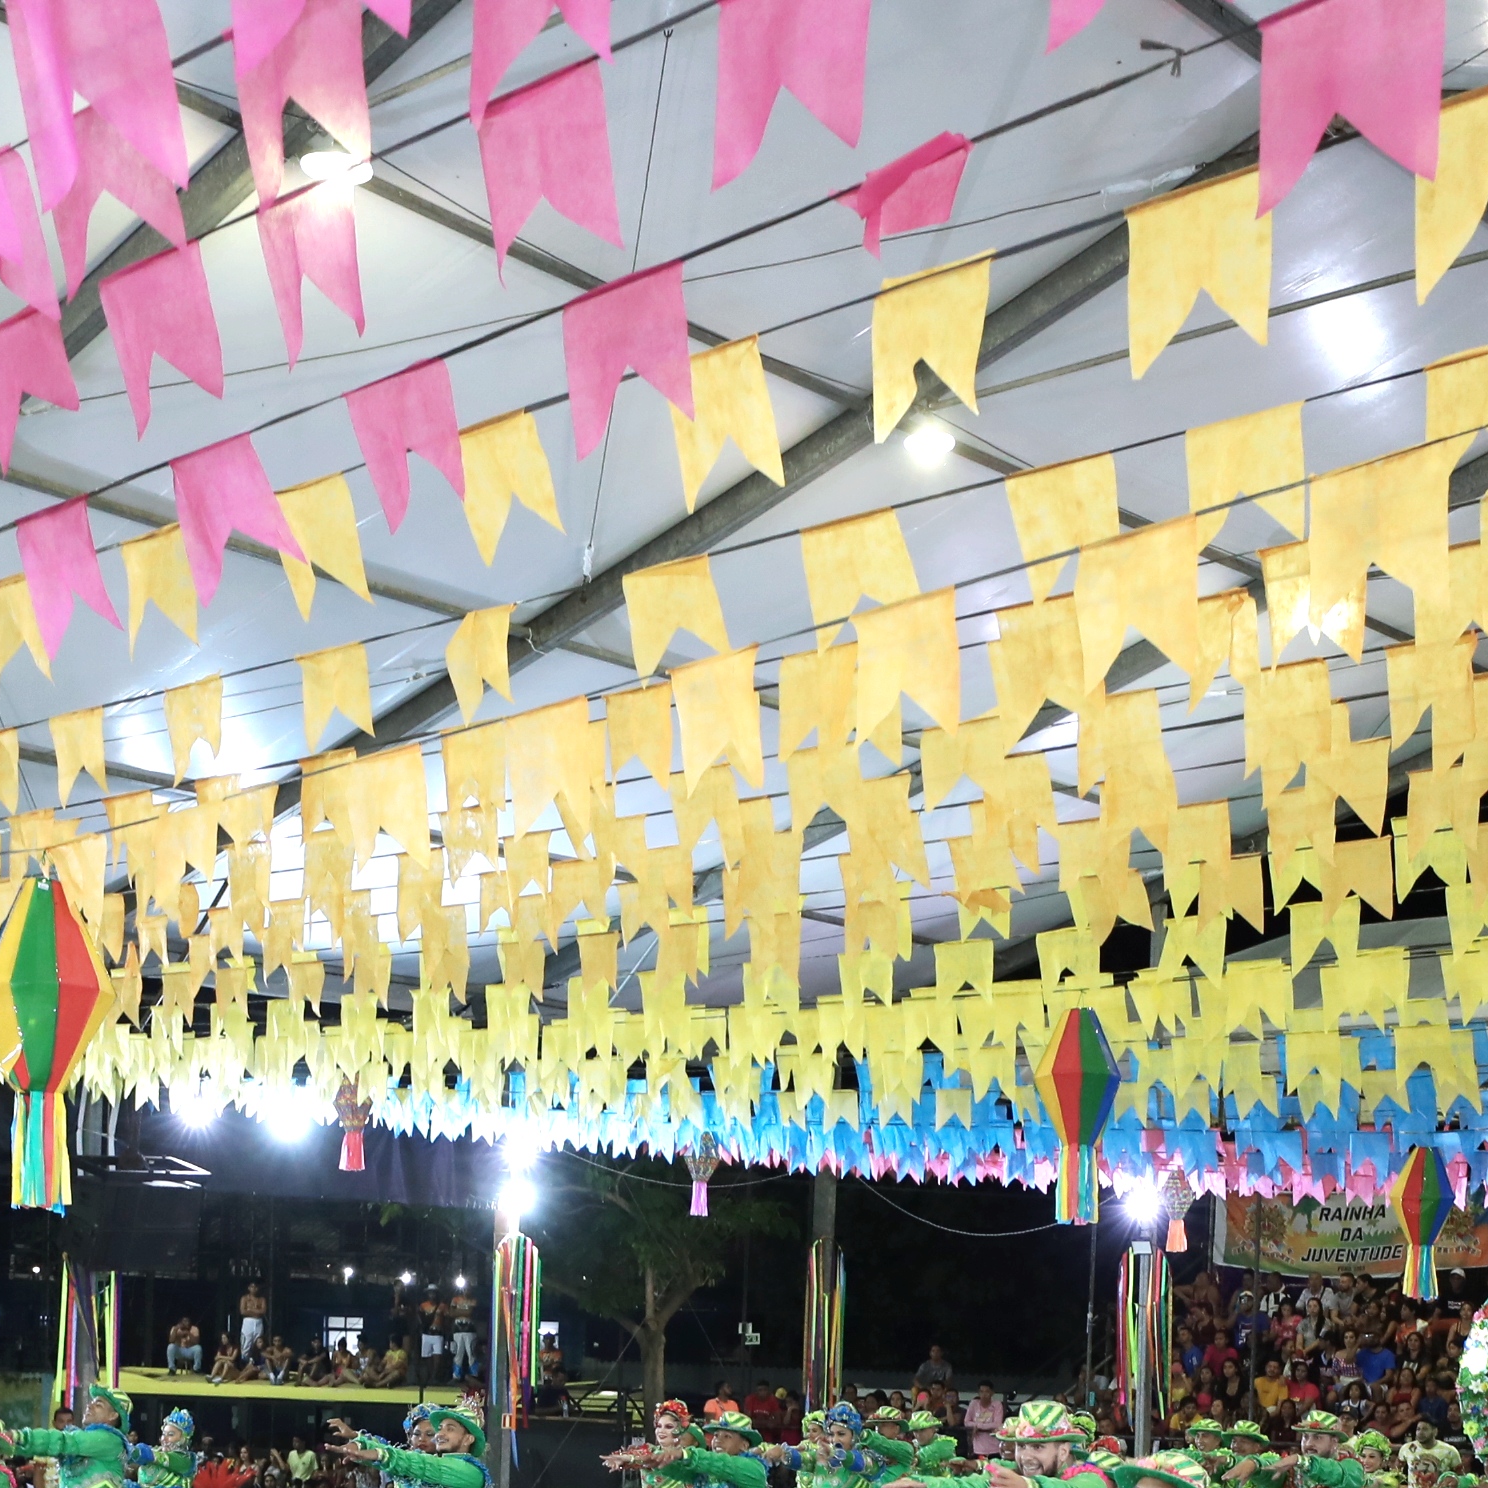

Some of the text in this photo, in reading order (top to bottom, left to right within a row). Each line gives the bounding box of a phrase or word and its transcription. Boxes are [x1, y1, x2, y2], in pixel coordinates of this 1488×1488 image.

[1319, 1204, 1387, 1222] RAINHA
[1340, 1227, 1364, 1242] DA
[1301, 1244, 1404, 1262] JUVENTUDE
